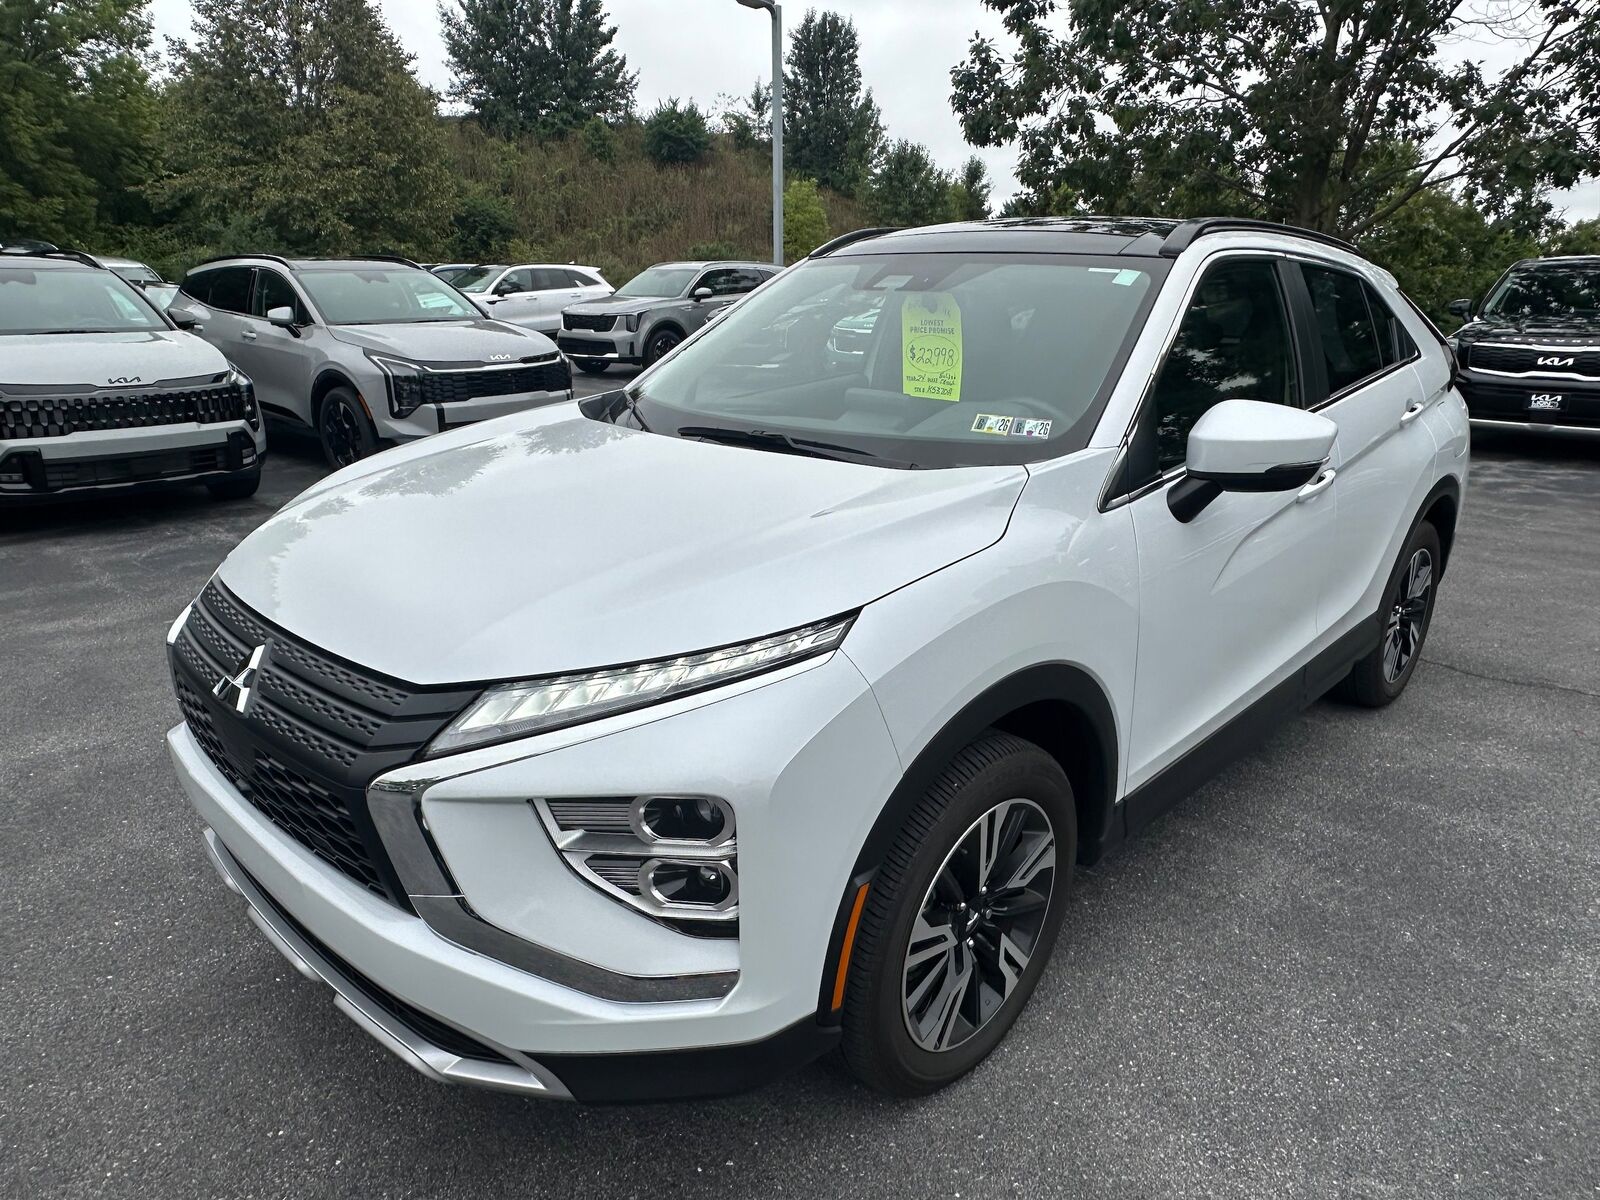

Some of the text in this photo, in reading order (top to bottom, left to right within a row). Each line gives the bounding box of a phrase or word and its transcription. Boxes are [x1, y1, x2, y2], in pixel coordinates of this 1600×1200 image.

[910, 326, 955, 335] PRICE PROMISE
[1537, 356, 1575, 367] KIA
[107, 376, 142, 385] KIA
[1530, 394, 1563, 403] KIA
[998, 418, 1011, 432] 26
[1038, 422, 1050, 436] 26
